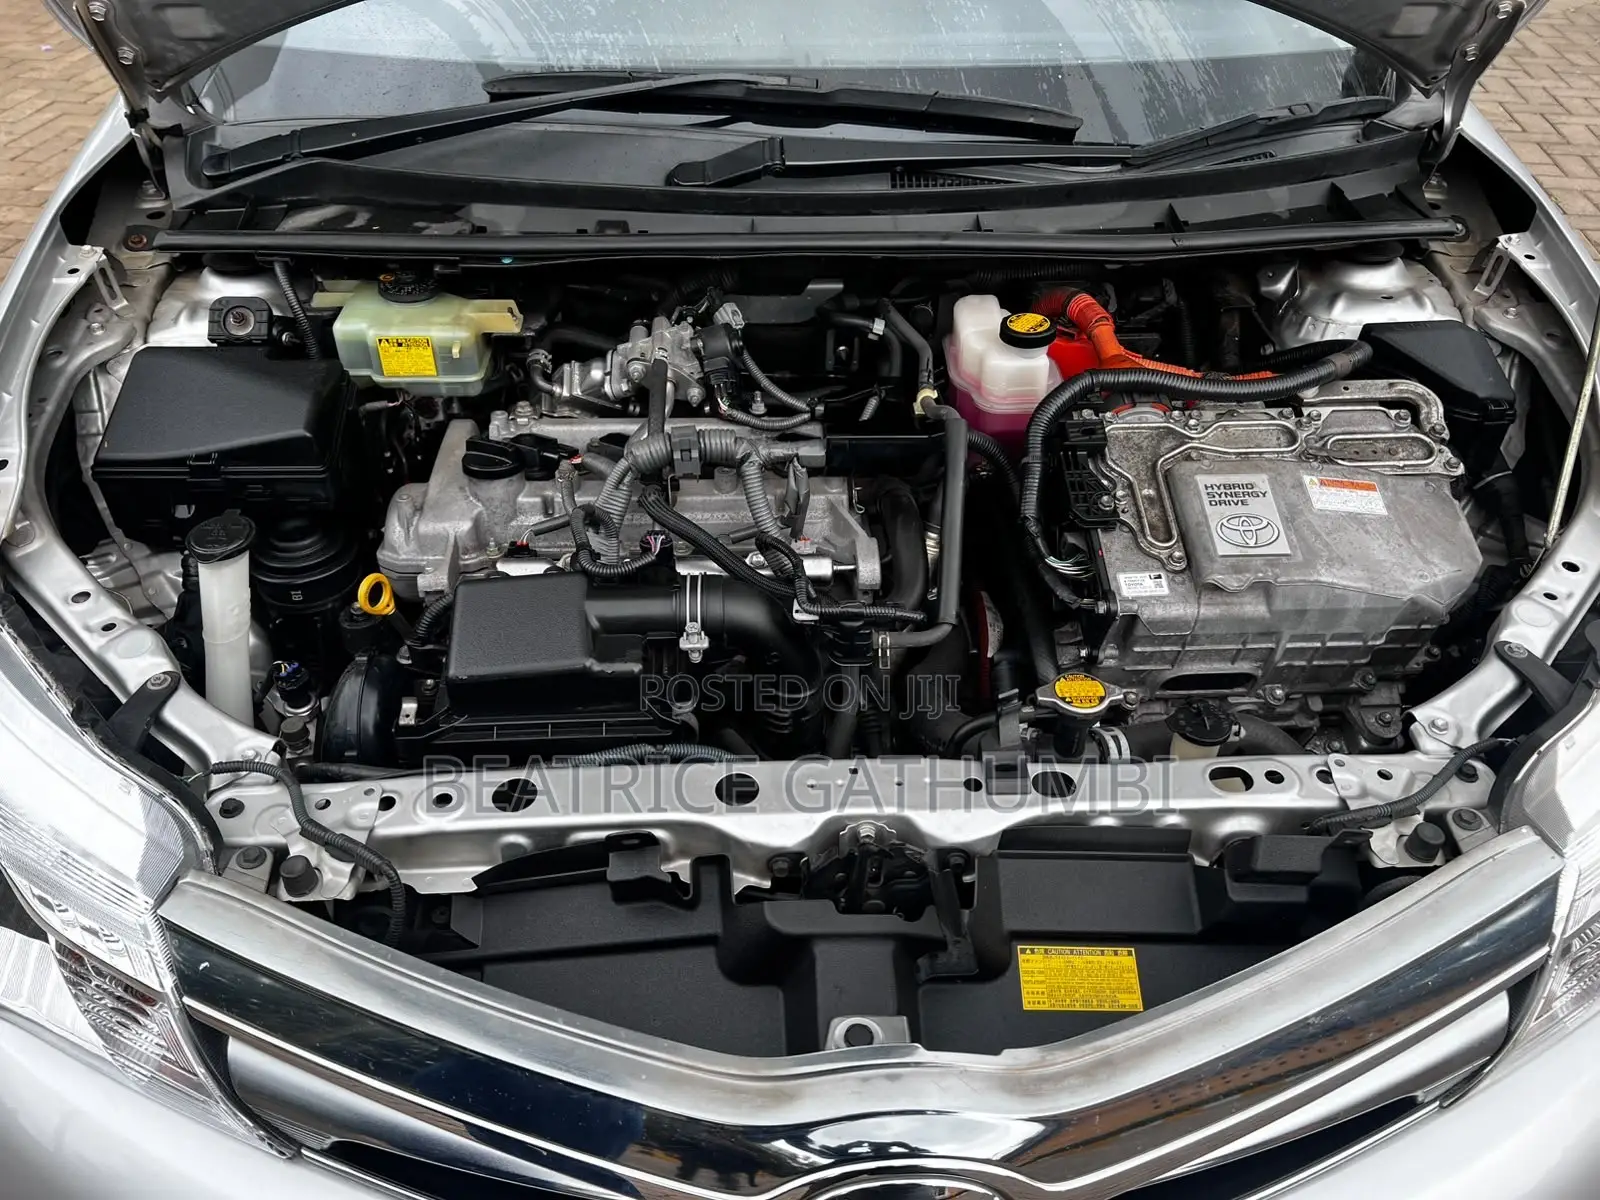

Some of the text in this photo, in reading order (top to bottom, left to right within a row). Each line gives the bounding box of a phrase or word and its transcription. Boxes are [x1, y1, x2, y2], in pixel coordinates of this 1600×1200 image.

[1206, 490, 1268, 499] SYNERGY
[1208, 499, 1250, 507] DRIVE
[1047, 948, 1071, 956] CAUTION
[1073, 948, 1102, 957] ATTENTION
